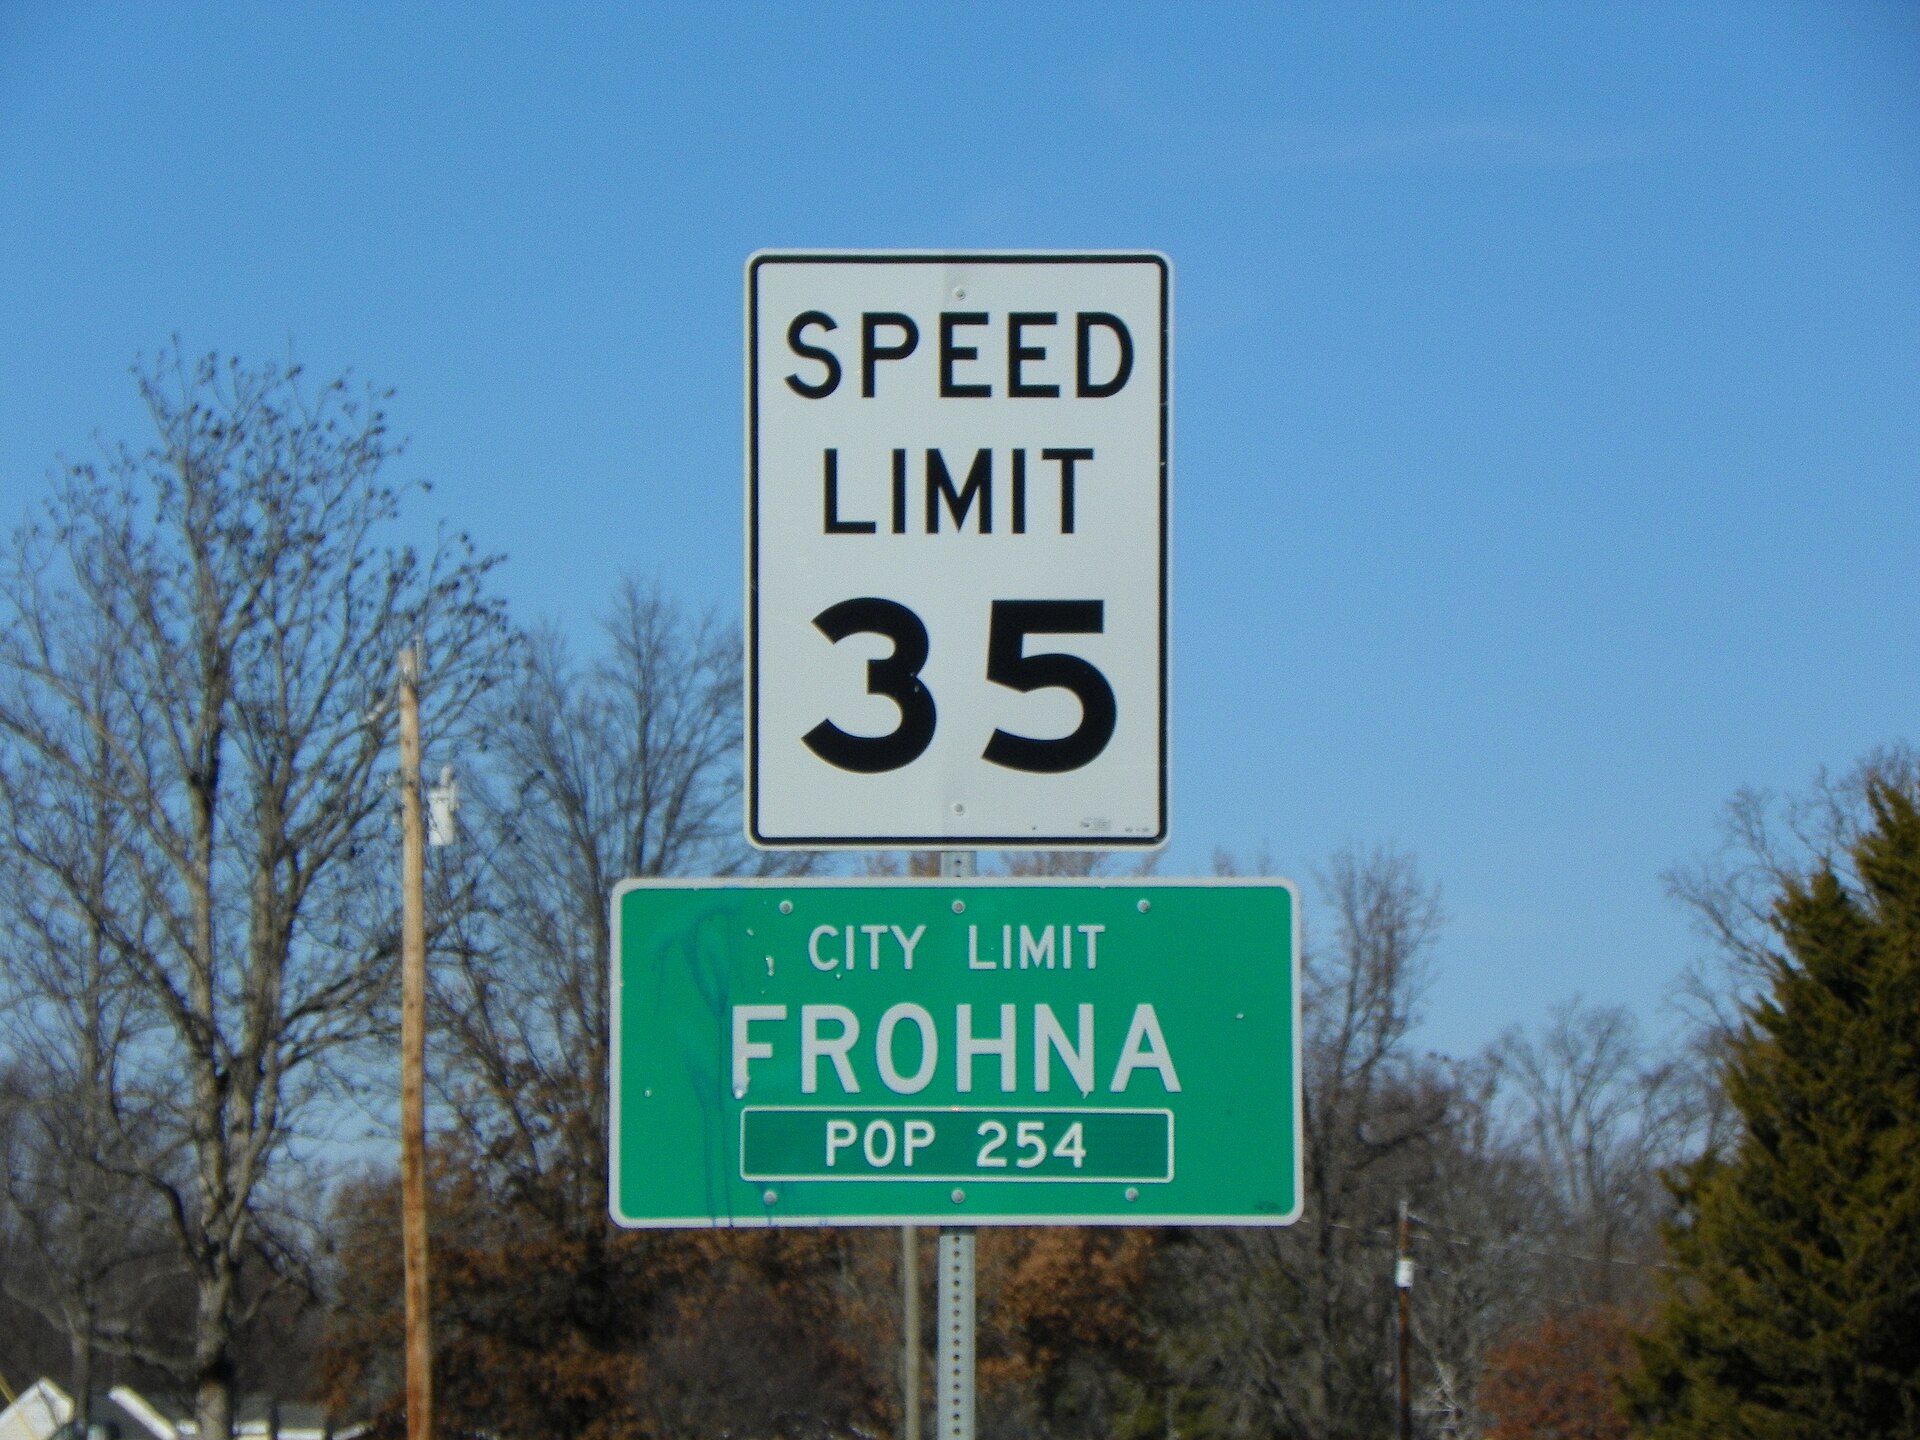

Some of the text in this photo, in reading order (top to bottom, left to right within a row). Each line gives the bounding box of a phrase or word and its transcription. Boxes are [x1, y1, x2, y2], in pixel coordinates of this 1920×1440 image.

[784, 310, 1135, 399] SPEED
[823, 448, 1094, 534] LIMIT
[801, 597, 1118, 775] 35
[807, 925, 1105, 972] CITY LIMIT
[731, 1002, 1182, 1097] FROHNA
[825, 1121, 1087, 1168] POP 254
